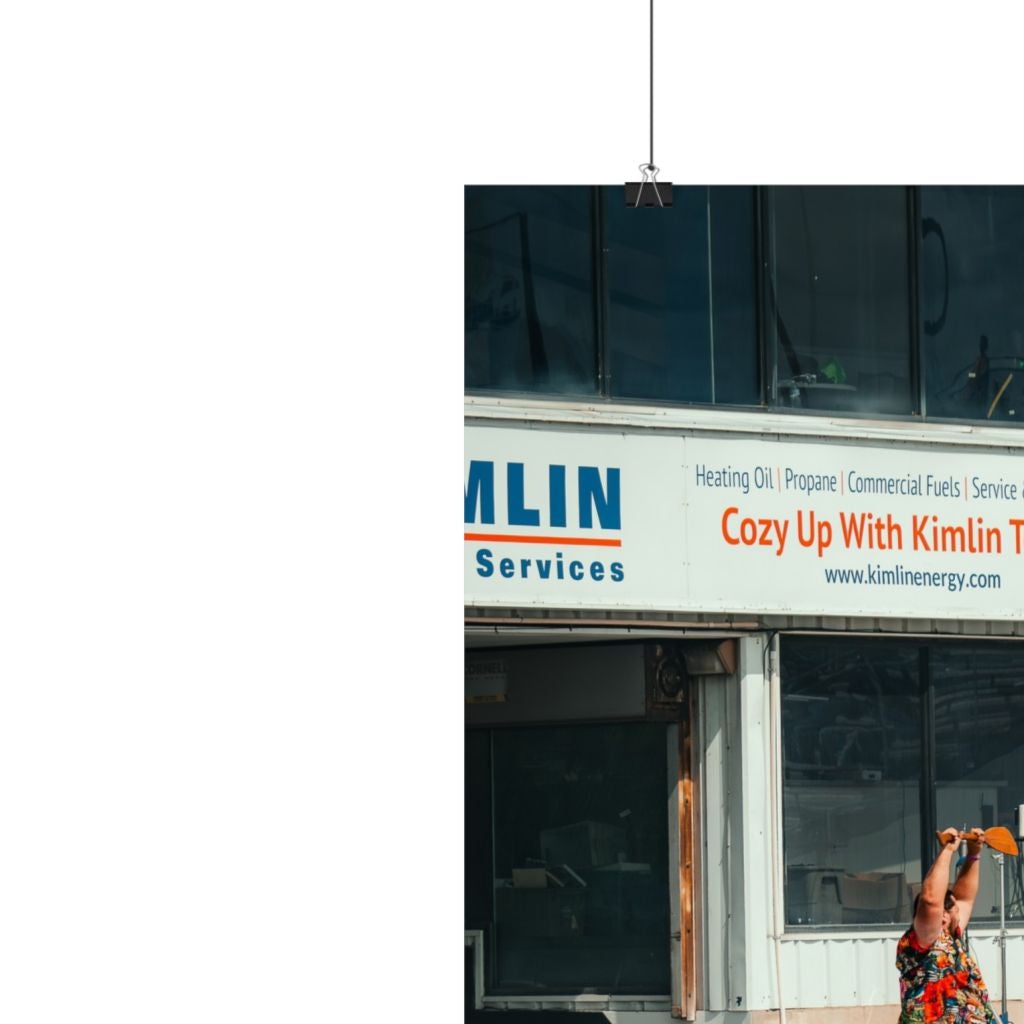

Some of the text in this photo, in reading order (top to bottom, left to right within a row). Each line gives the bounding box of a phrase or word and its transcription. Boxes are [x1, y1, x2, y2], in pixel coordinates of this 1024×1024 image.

[464, 460, 621, 530] MLIN
[696, 464, 749, 494] Heating
[755, 467, 773, 490] Oil
[786, 468, 837, 495] Propane
[848, 470, 922, 496] Commercial
[926, 475, 960, 498] Fuels
[972, 477, 1017, 500] Service
[721, 506, 789, 556] Cozy
[797, 510, 832, 557] Up
[840, 512, 903, 550] With
[912, 515, 1002, 554] Kimlin
[476, 549, 624, 582] Services
[825, 564, 1001, 591] www.kimlinenergy.com
